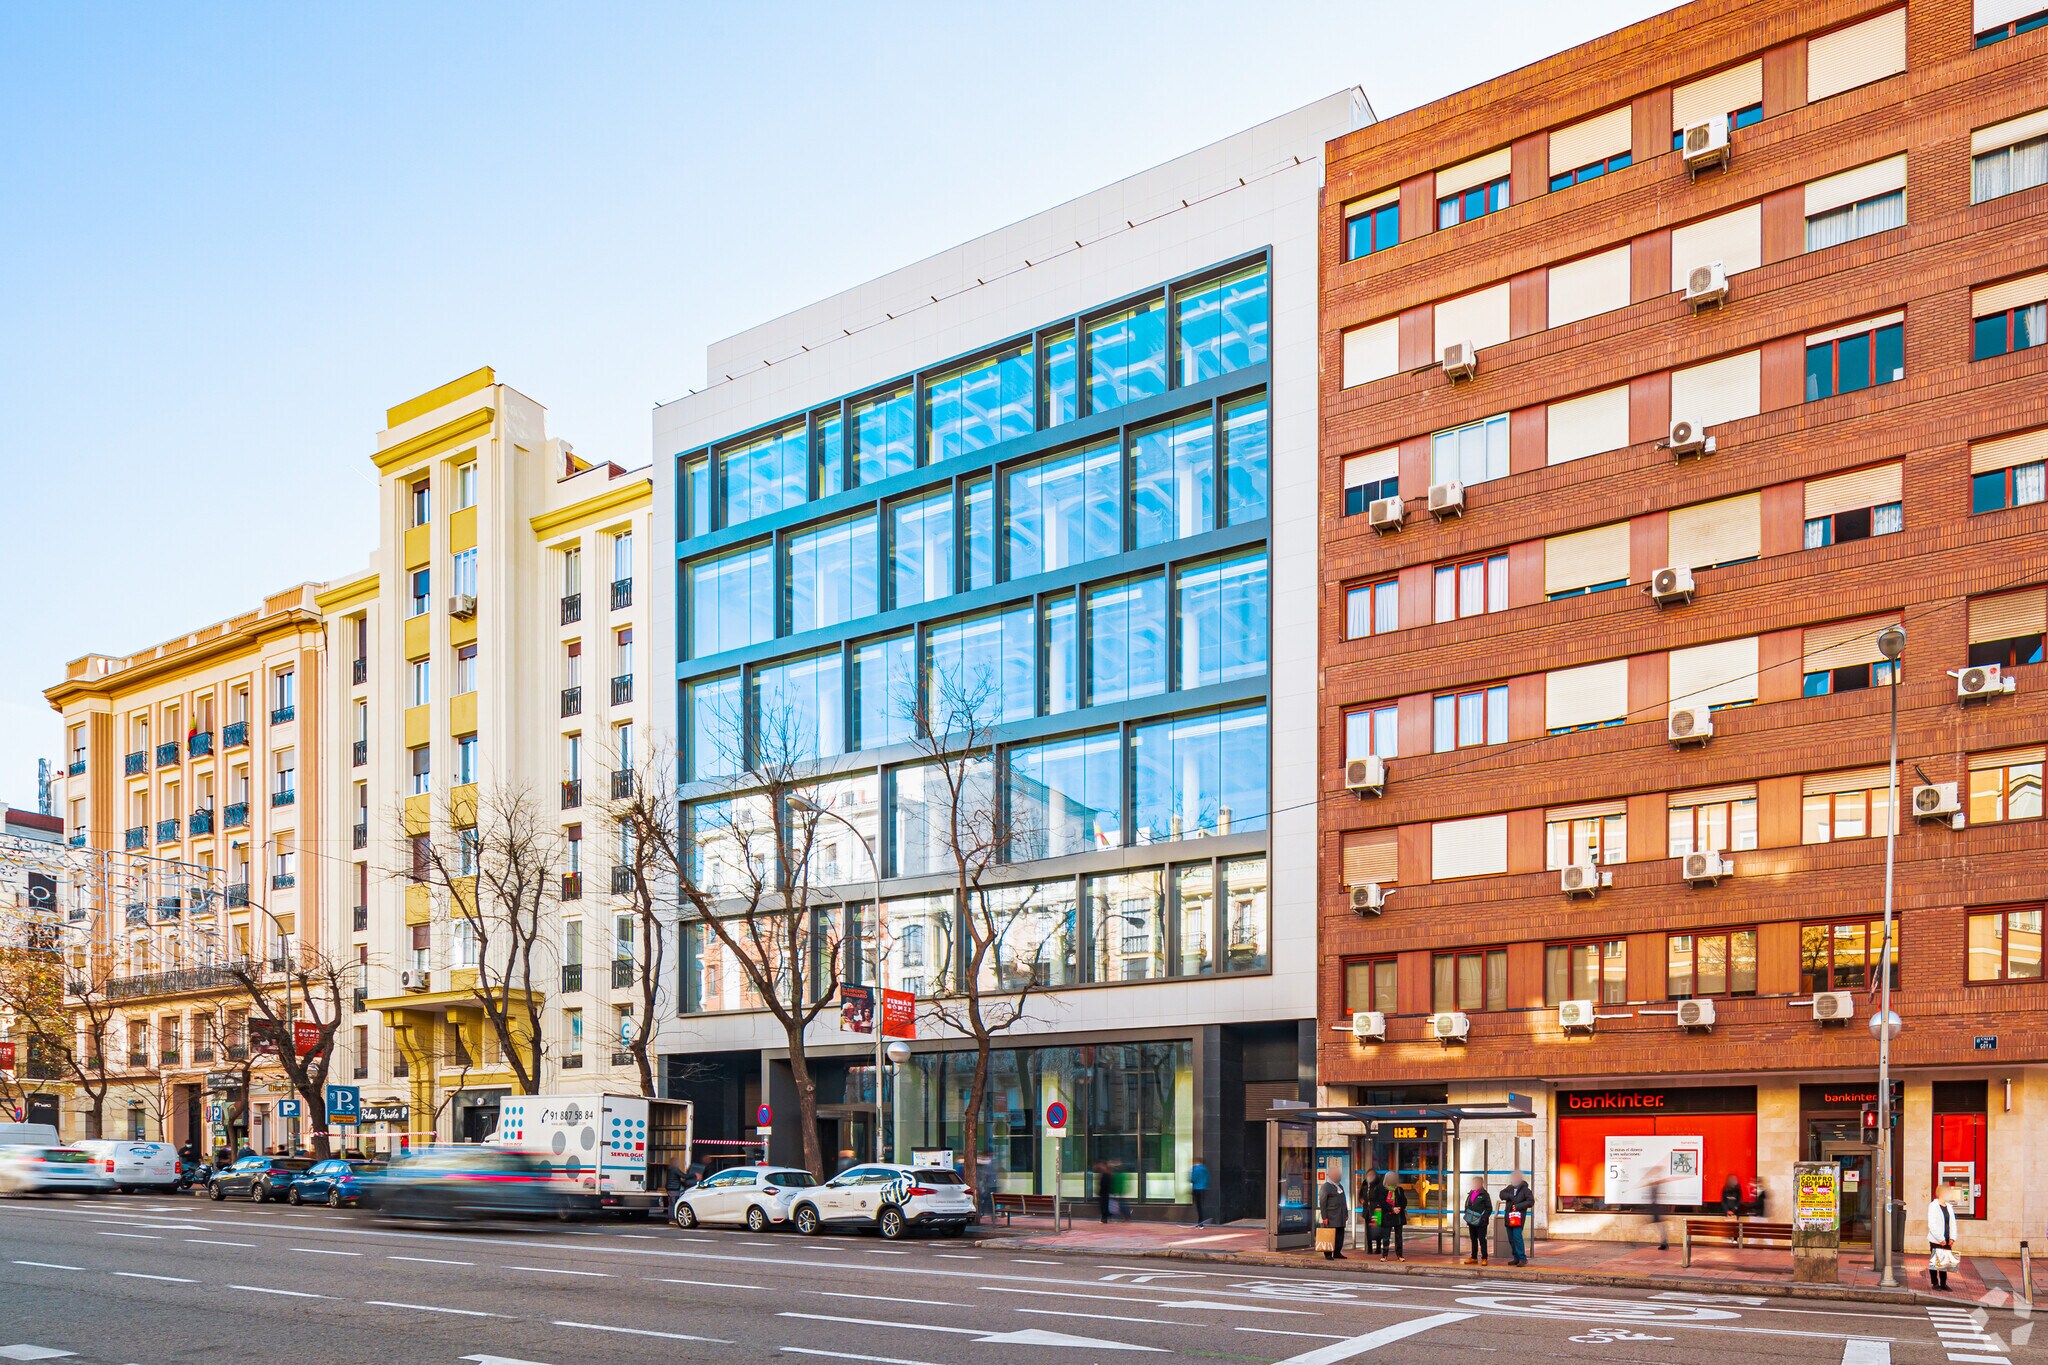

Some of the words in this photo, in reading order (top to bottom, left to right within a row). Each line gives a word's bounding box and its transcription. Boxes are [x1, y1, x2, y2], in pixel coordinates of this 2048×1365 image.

[335, 1090, 353, 1111] P
[213, 1107, 220, 1119] P
[283, 1102, 296, 1115] P
[550, 1111, 558, 1121] 91
[560, 1110, 572, 1120] 887
[574, 1110, 583, 1120] 58
[585, 1110, 593, 1120] 84
